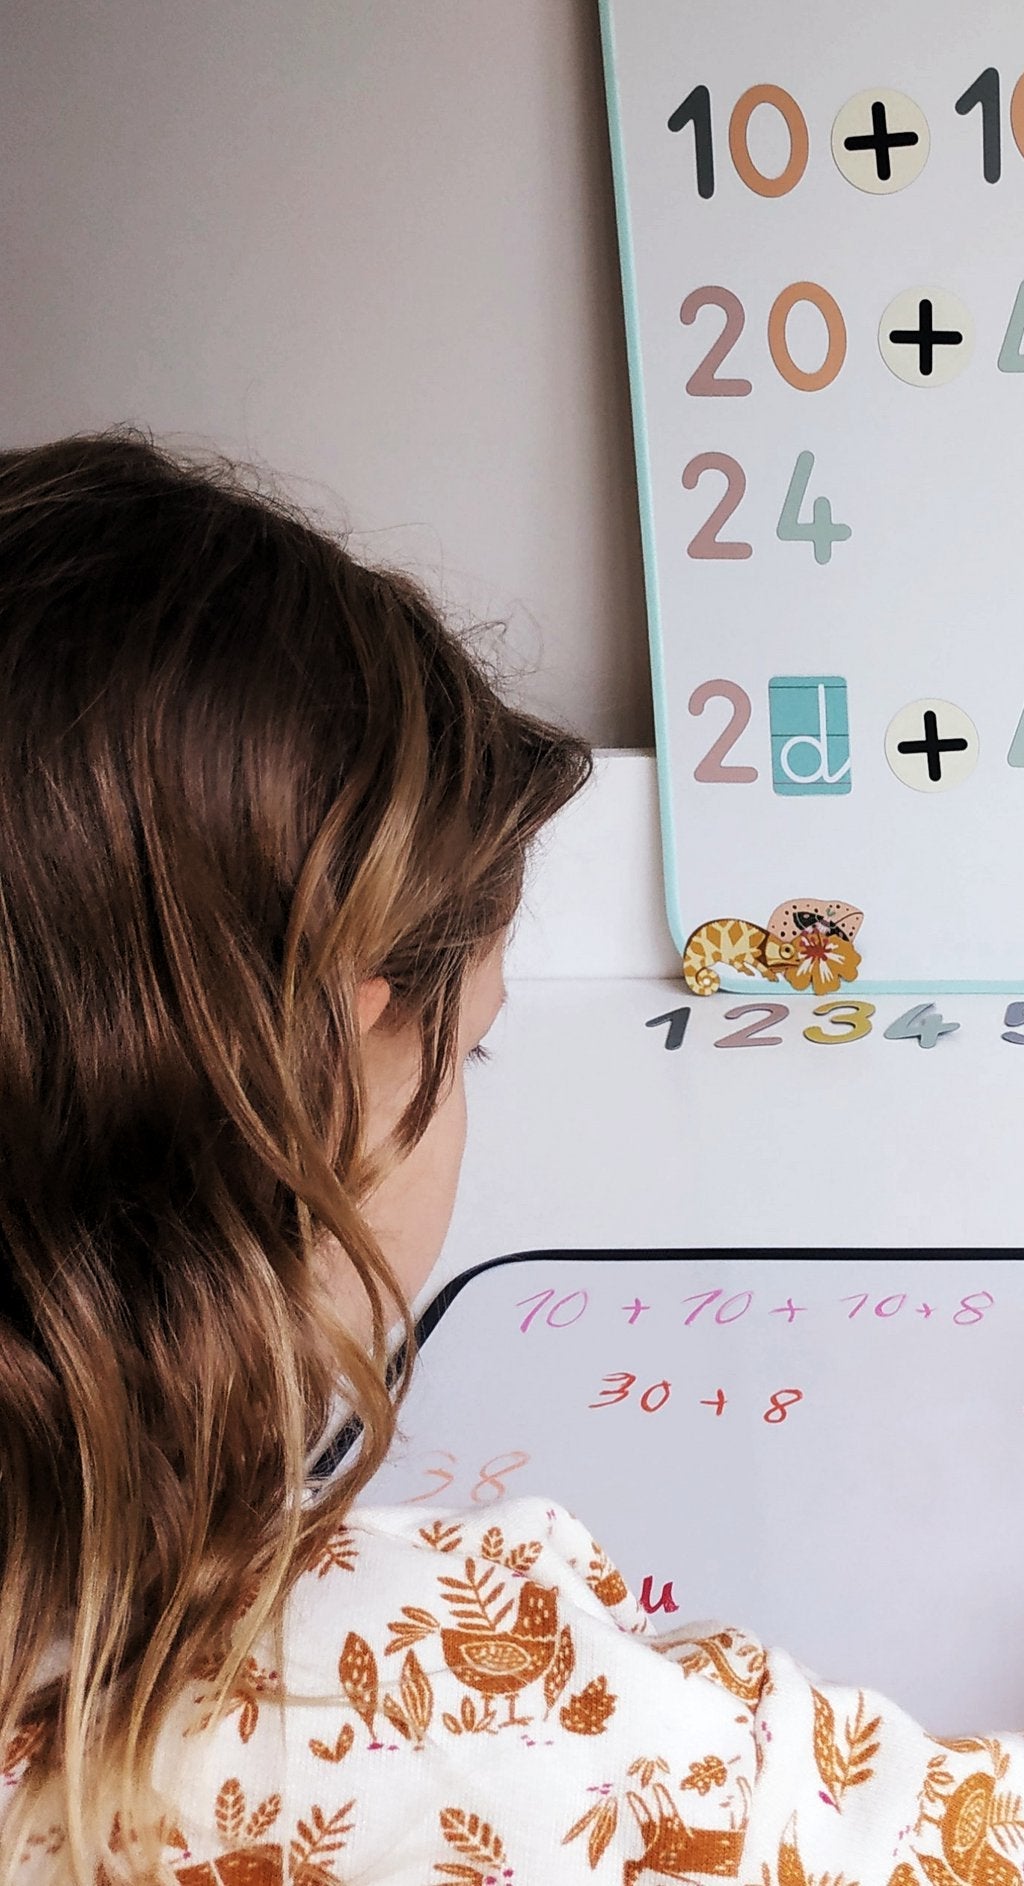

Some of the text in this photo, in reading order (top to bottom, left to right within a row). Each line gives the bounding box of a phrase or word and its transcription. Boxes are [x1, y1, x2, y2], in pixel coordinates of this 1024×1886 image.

[667, 83, 809, 199] 10
[679, 281, 847, 397] 20
[682, 450, 852, 565] 24
[645, 1005, 691, 1050] 1
[713, 1003, 791, 1048] 2
[803, 1000, 876, 1044] 3
[884, 1003, 961, 1049] 4
[516, 1289, 588, 1333] 10
[681, 1289, 754, 1325] 10
[839, 1292, 907, 1319] 10
[953, 1290, 994, 1325] 8
[588, 1372, 671, 1413] 30
[763, 1388, 803, 1423] 8
[400, 1450, 531, 1504] 38
